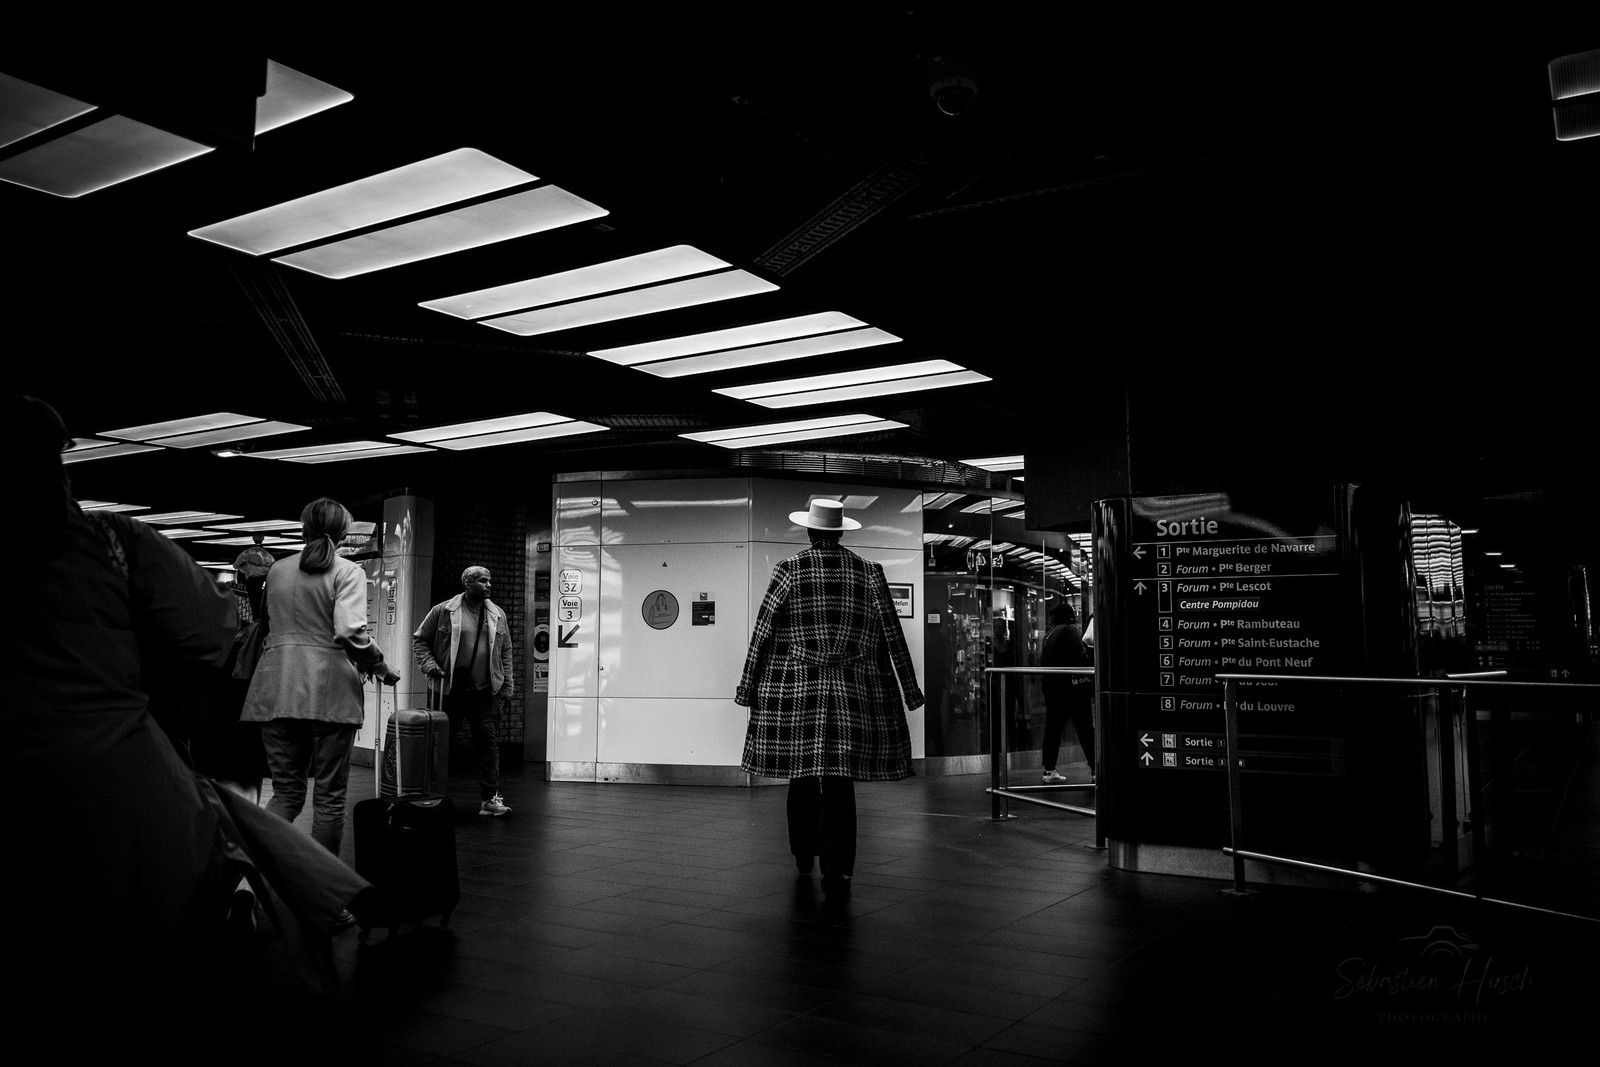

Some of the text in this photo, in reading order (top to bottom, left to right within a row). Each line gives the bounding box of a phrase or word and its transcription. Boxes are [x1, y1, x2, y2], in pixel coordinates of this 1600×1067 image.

[1156, 517, 1218, 537] Sortie
[1192, 544, 1251, 558] Marguerite
[1254, 544, 1268, 553] de
[1270, 542, 1315, 552] Navarre
[1176, 564, 1208, 574] Forum
[1236, 562, 1272, 574] Berger
[562, 572, 578, 580] Voie
[1162, 583, 1168, 592] 3
[1177, 583, 1209, 592] Forum
[1236, 581, 1272, 592] Lescot
[1180, 599, 1259, 611] Centre Pompidou
[567, 611, 572, 619] 3
[1178, 620, 1210, 630] Forum
[1237, 618, 1300, 629] Rambuteau
[1178, 638, 1210, 648] Forum
[1238, 638, 1320, 648] Saint-Eustache
[1179, 656, 1211, 666] Forum
[1238, 657, 1252, 667] du
[1255, 657, 1282, 667] Pont
[1284, 657, 1312, 668] Neuf
[1179, 675, 1212, 685] Forum
[1180, 700, 1213, 710] Forum
[1240, 700, 1254, 712] du
[1257, 701, 1294, 712] Louvre
[1185, 738, 1213, 746] Sortie
[1186, 756, 1214, 765] Sortie
